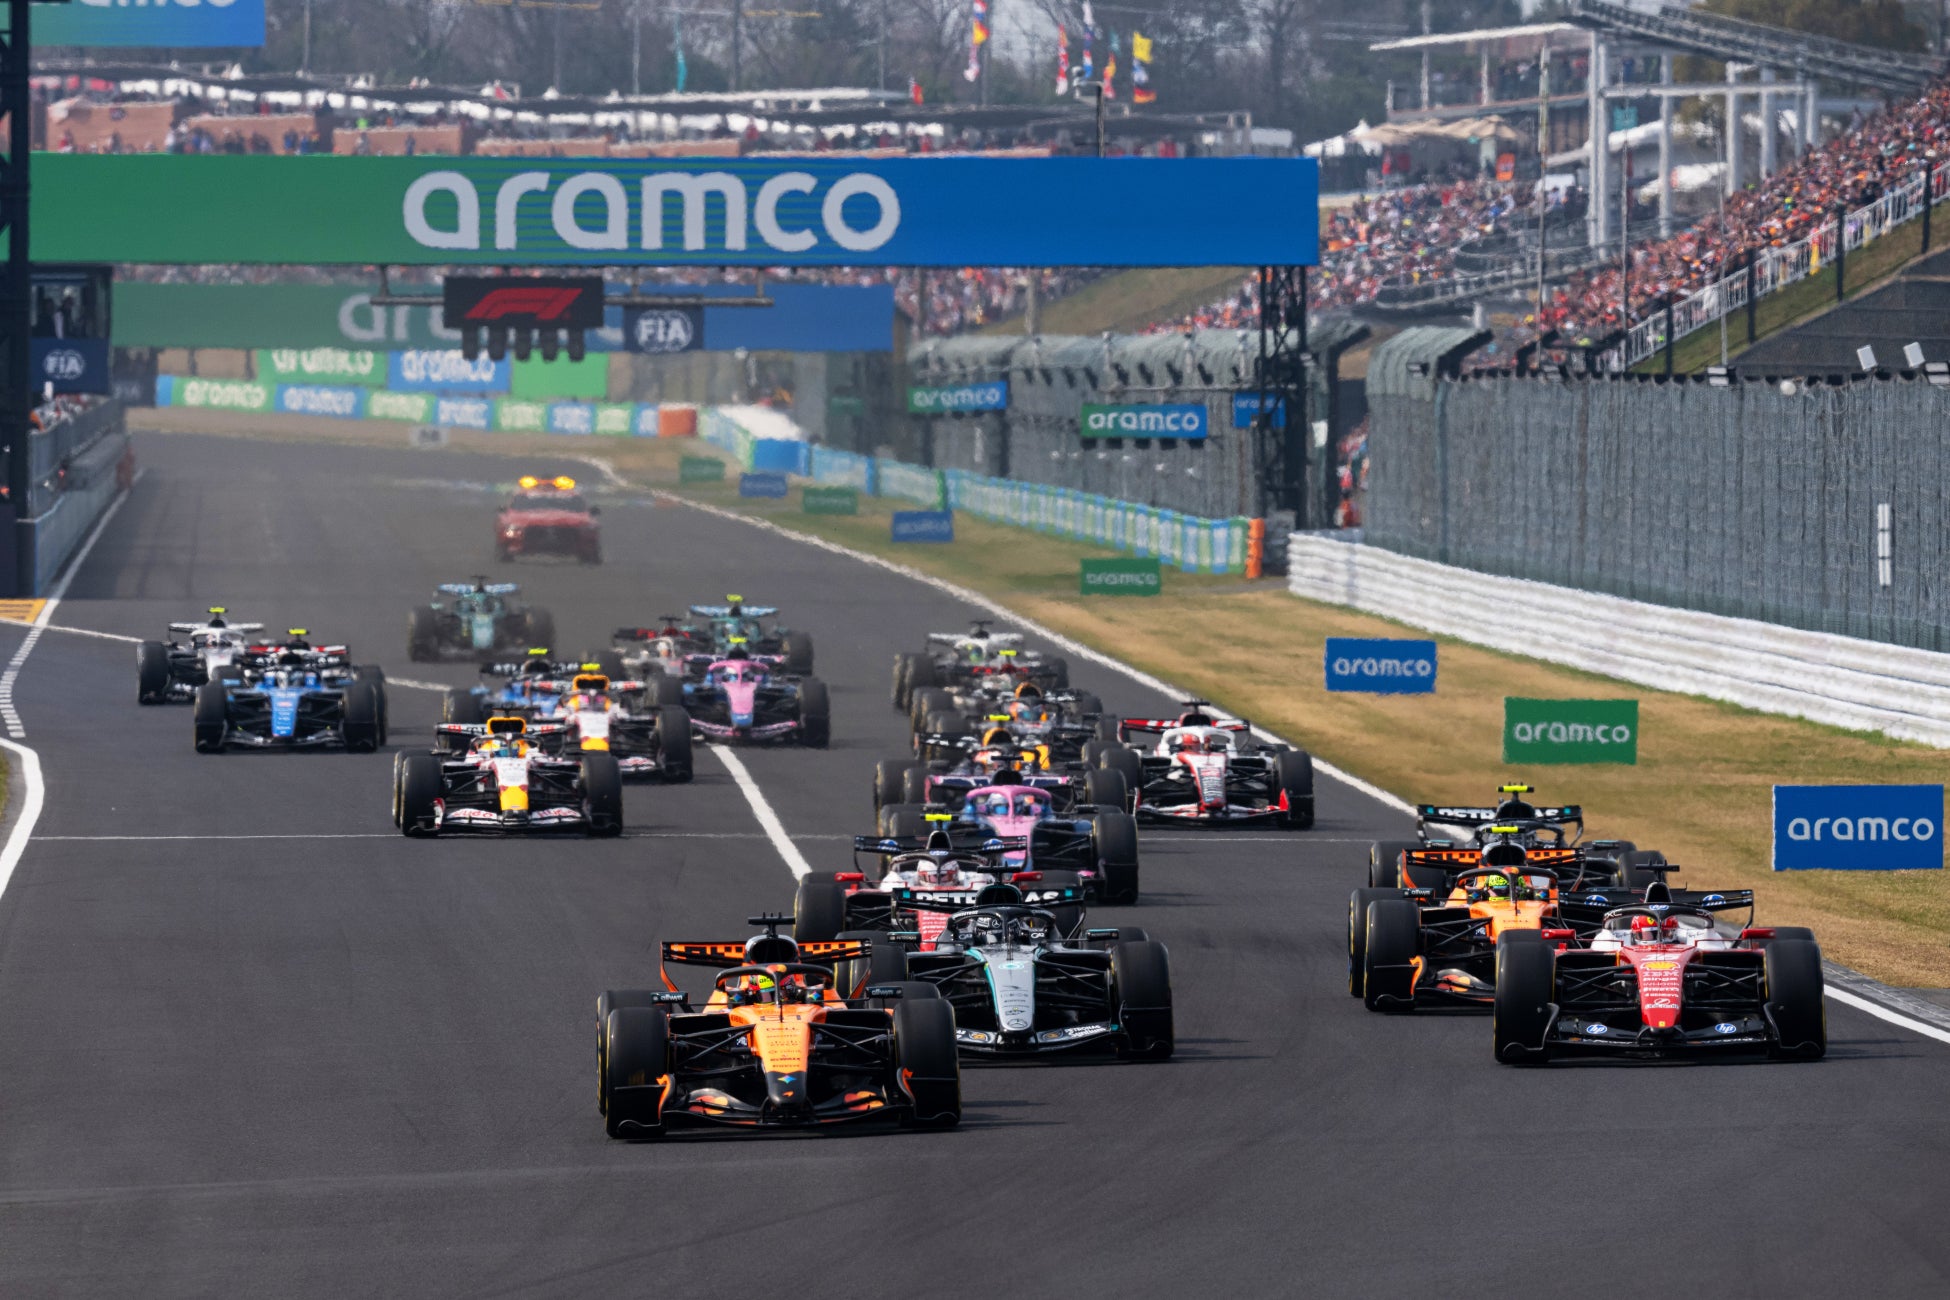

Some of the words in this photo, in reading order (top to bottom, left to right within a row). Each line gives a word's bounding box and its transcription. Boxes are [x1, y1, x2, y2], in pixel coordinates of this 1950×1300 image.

[404, 171, 900, 252] aramco
[638, 319, 687, 343] FIA
[45, 356, 84, 374] FIA
[913, 386, 1001, 408] aramco
[1088, 410, 1200, 432] aramco
[1086, 570, 1158, 587] aramco
[1334, 656, 1432, 678] aramco
[1513, 720, 1630, 744] aramco
[1787, 816, 1935, 841] aramco
[916, 891, 1060, 904] PETRAS
[1587, 1025, 1607, 1034] hp
[1716, 1023, 1736, 1034] hp
